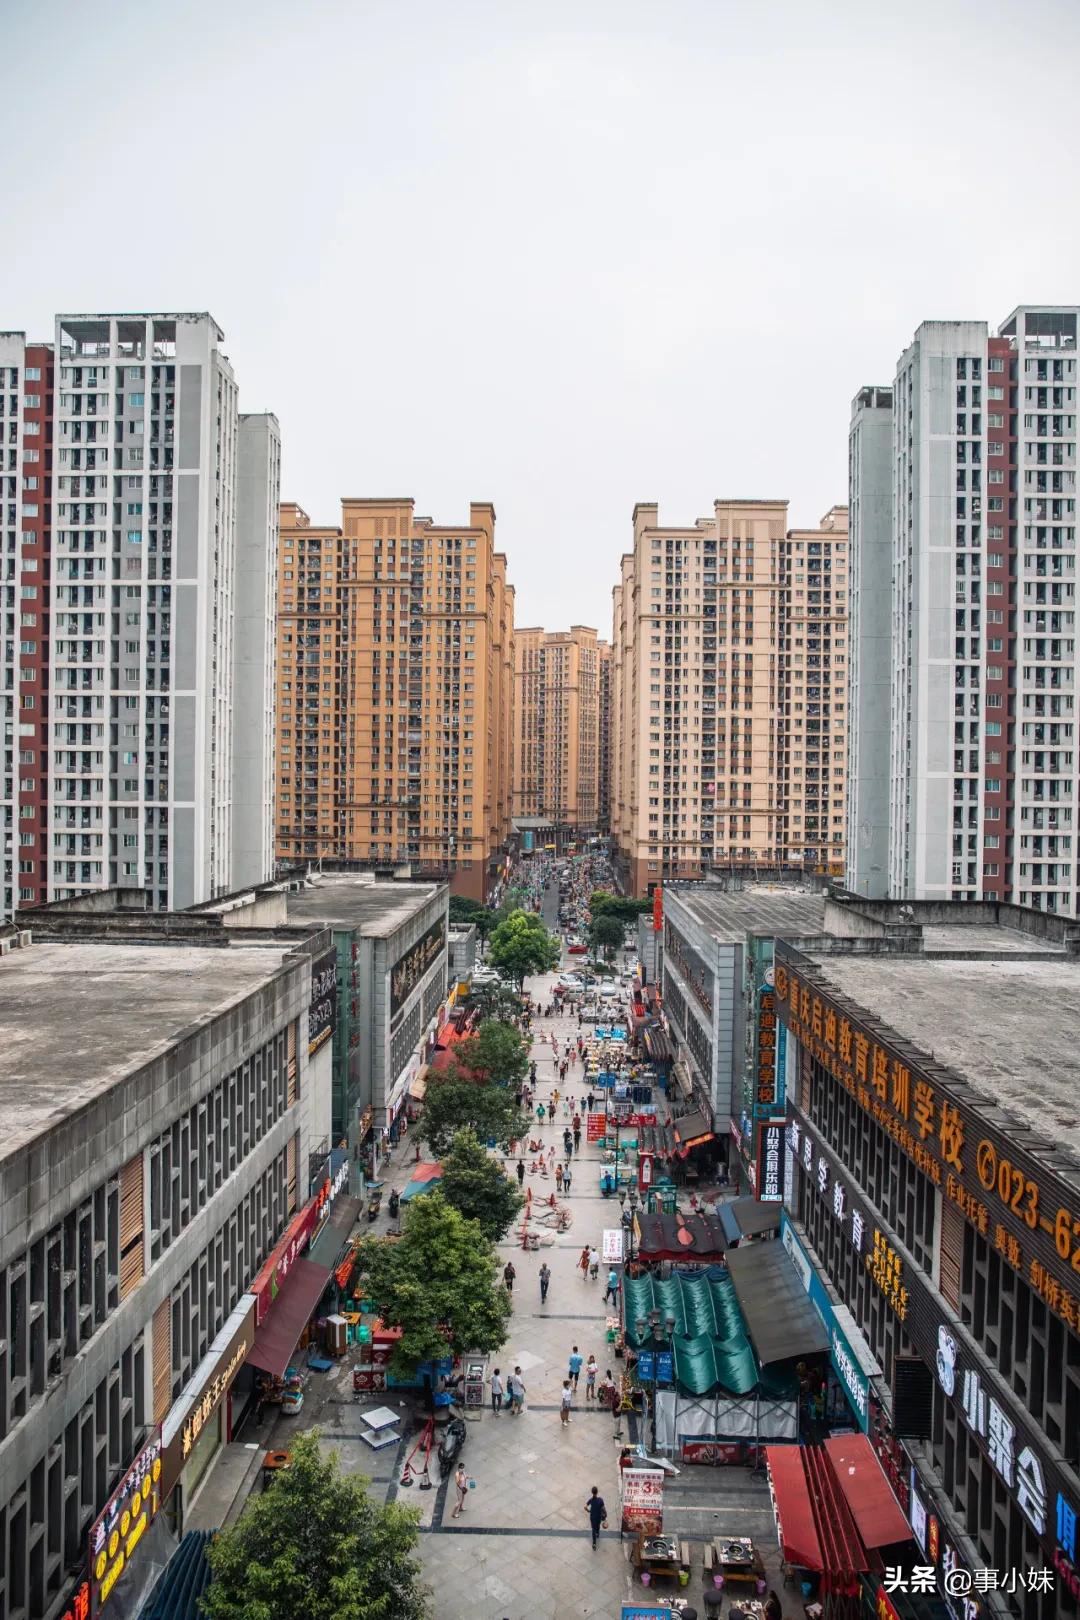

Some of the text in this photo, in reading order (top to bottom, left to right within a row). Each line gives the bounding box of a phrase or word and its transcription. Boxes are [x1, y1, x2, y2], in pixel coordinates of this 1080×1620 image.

[761, 994, 775, 1101] 启迪教育学校
[790, 977, 965, 1173] 重庆启迪教育培训学校
[765, 1126, 780, 1195] 小聚会俱乐部
[946, 1172, 989, 1234] 作业托管
[995, 1223, 1022, 1270] 奥数
